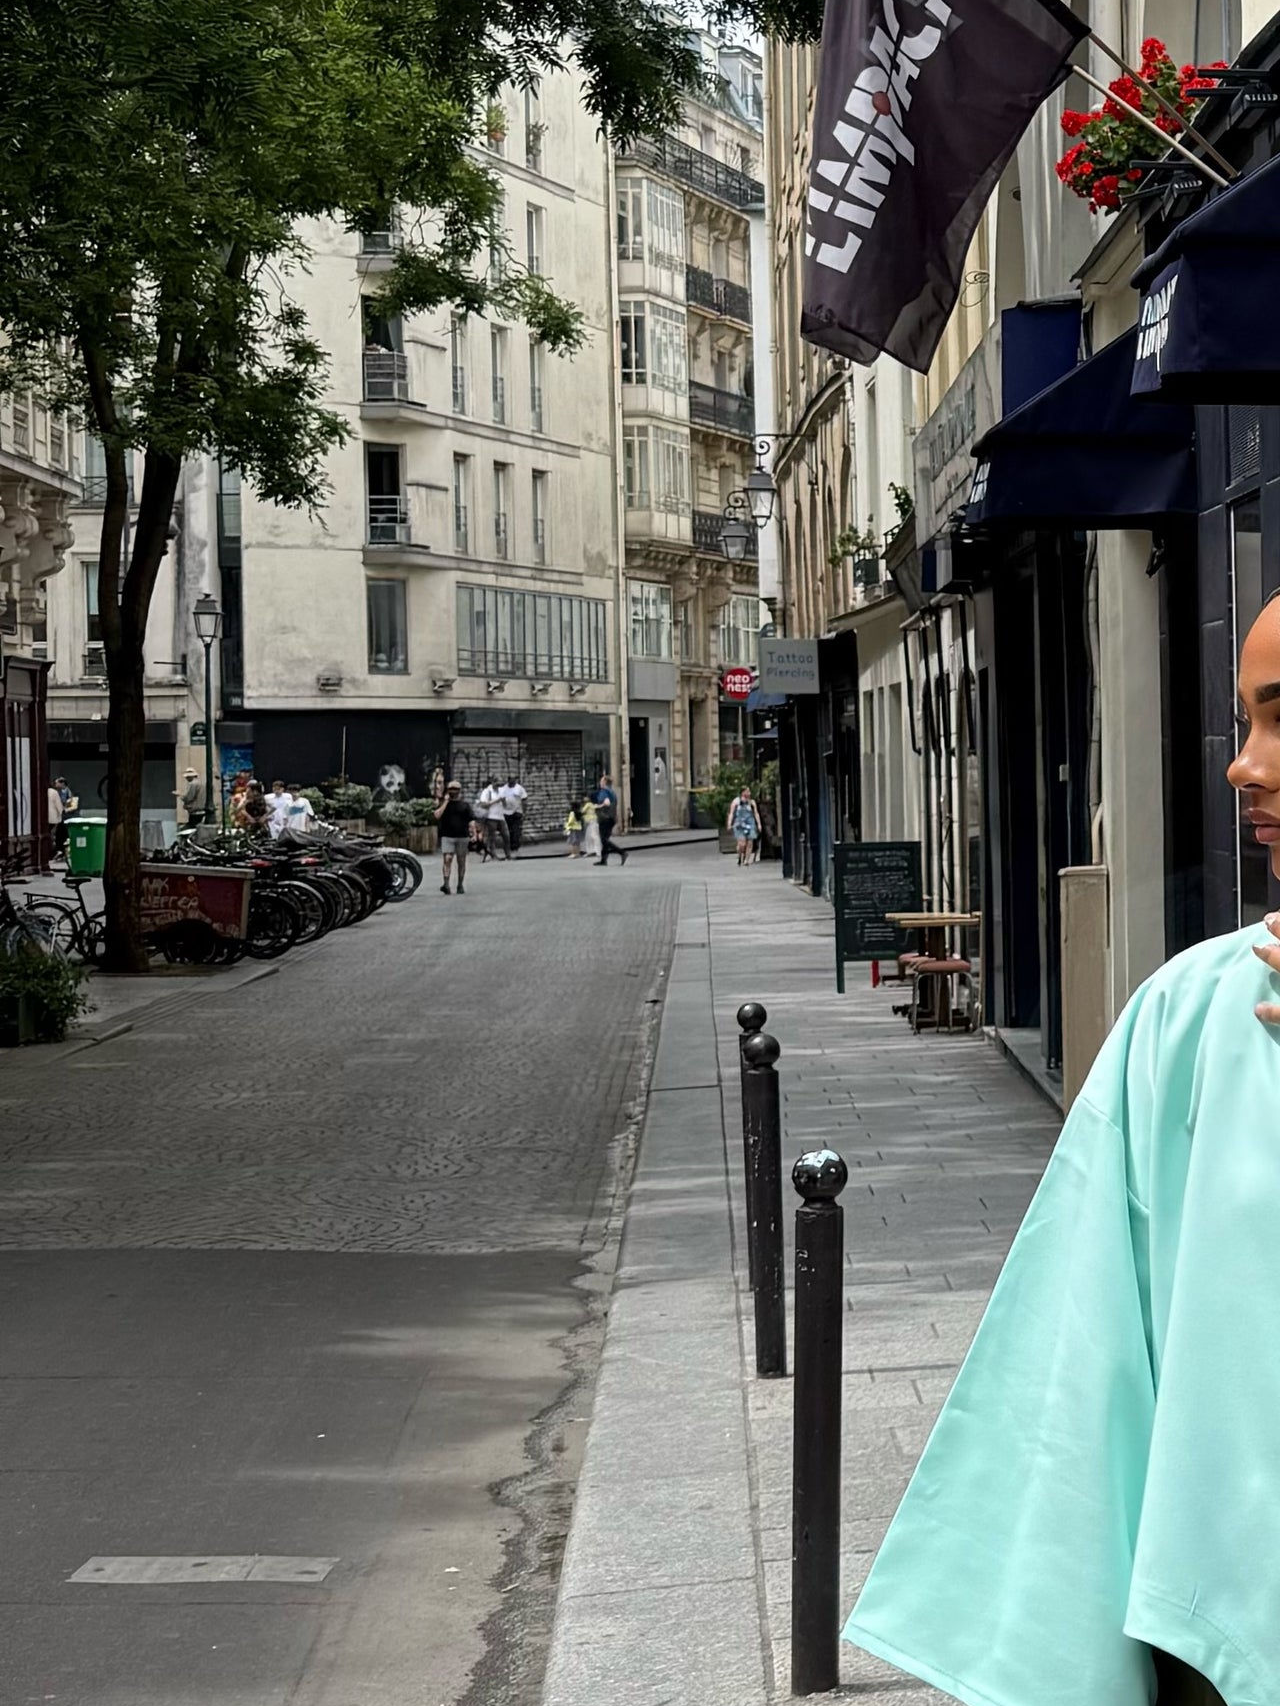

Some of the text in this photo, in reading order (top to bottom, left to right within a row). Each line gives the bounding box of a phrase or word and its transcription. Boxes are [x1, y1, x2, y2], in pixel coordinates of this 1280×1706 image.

[767, 652, 813, 664] Tattoo
[726, 674, 750, 683] neo
[766, 667, 814, 680] Piercing
